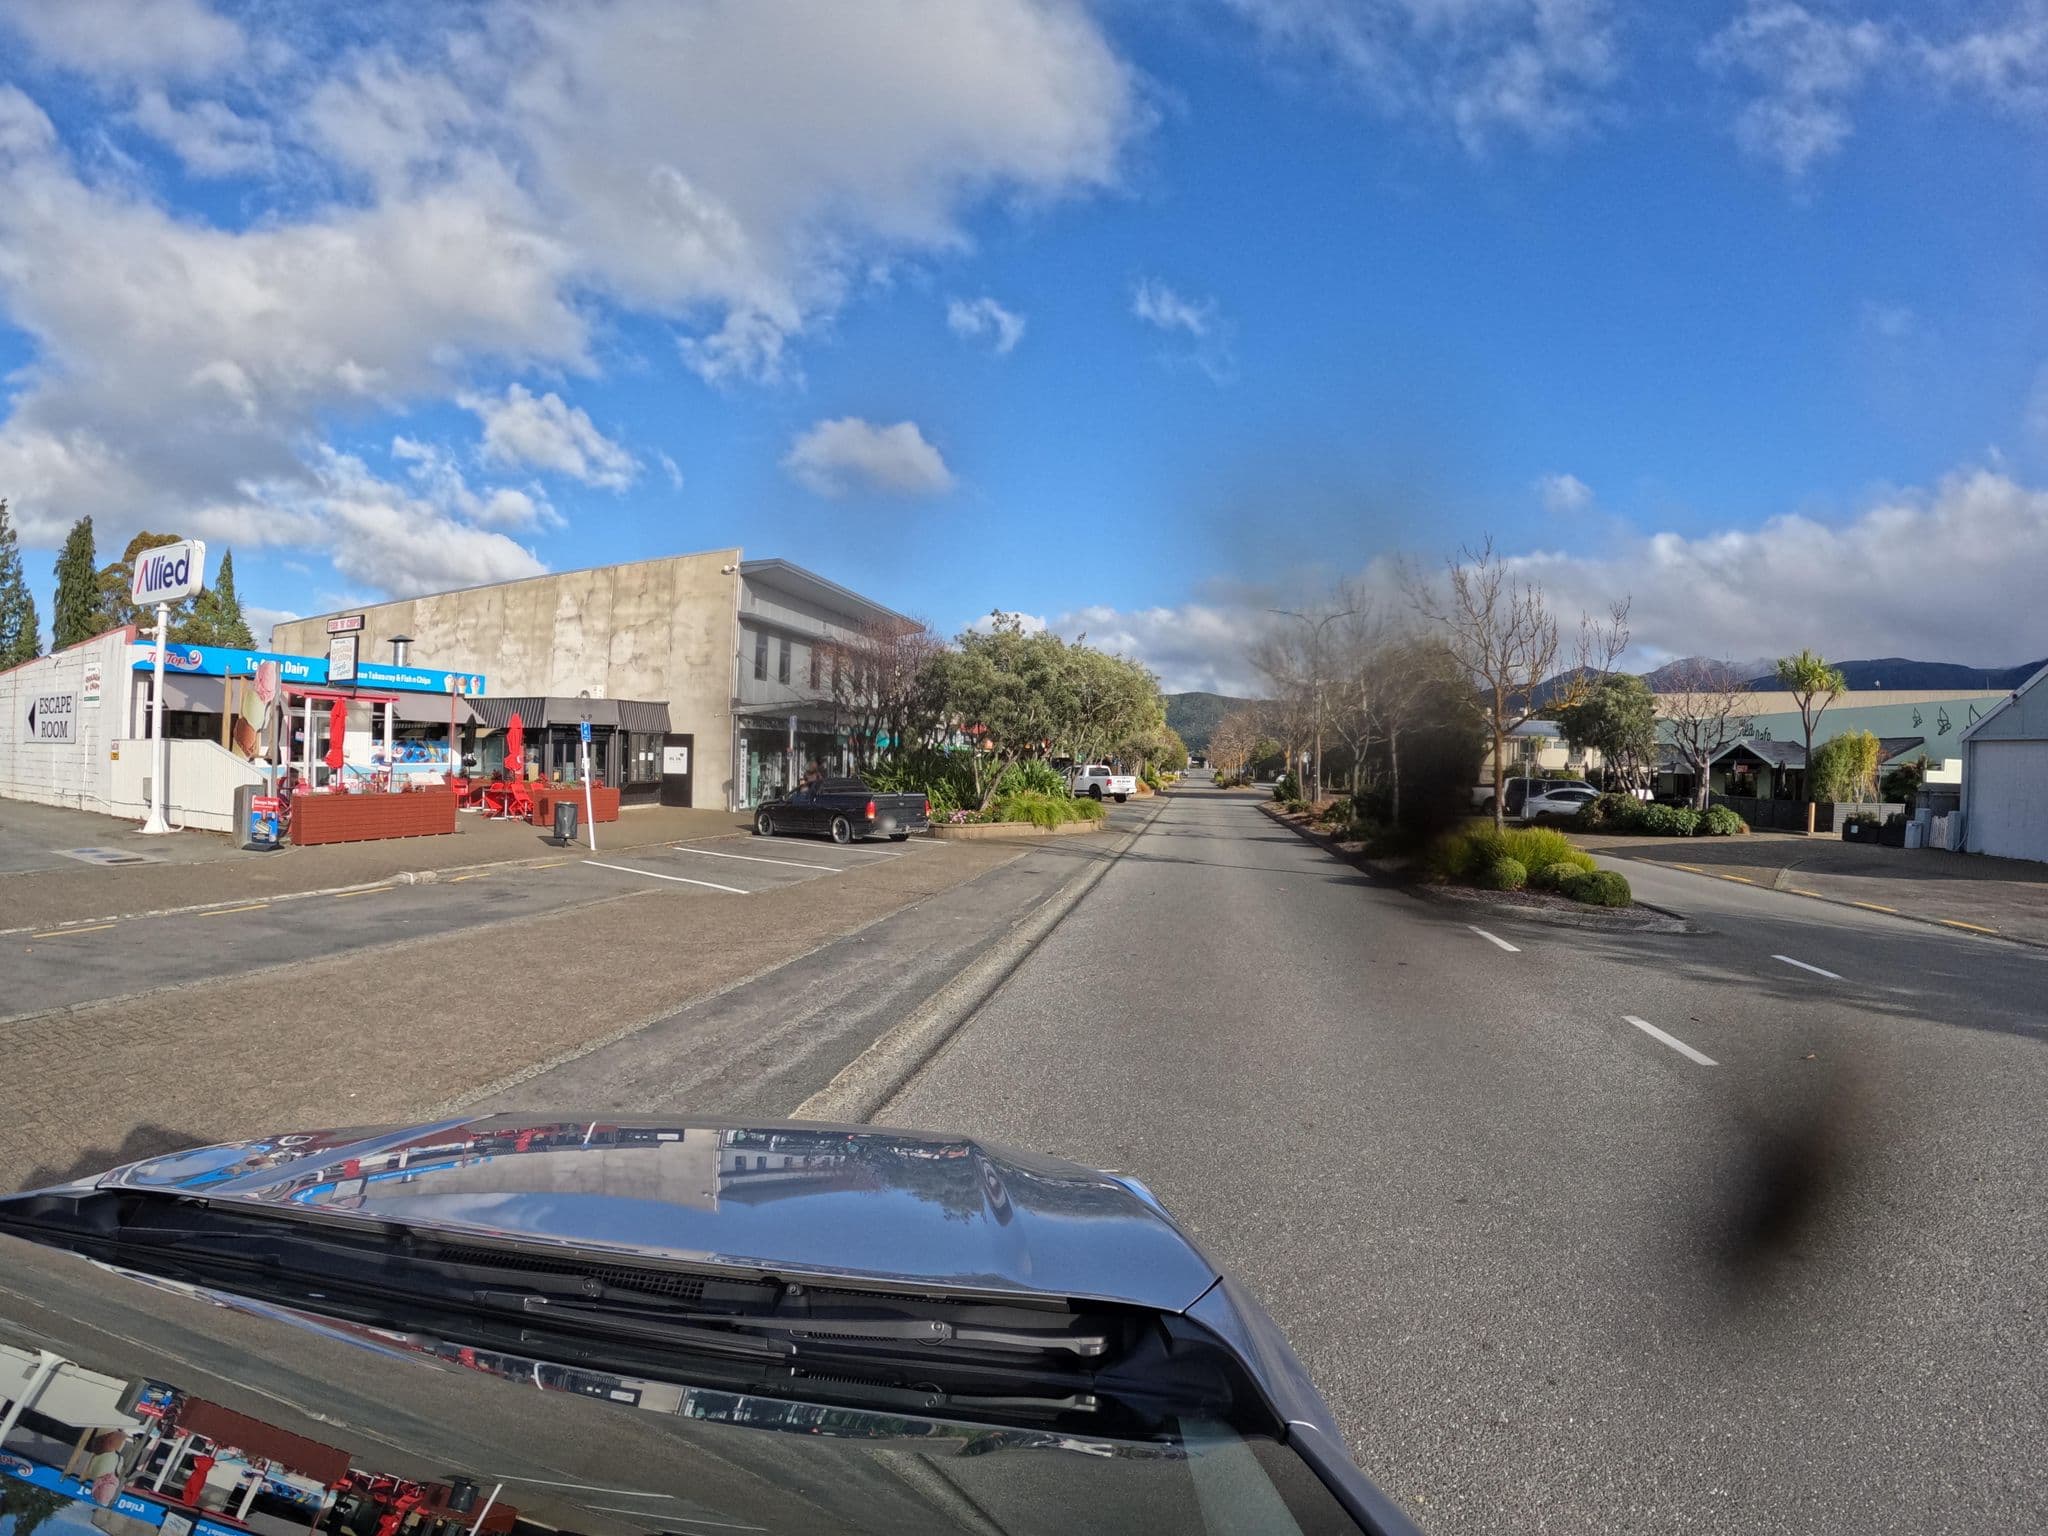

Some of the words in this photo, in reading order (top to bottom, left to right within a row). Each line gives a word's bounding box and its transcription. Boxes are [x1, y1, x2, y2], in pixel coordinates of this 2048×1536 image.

[136, 549, 190, 594] Allied
[166, 653, 187, 666] Top
[246, 657, 258, 671] Te
[285, 661, 310, 677] Dairy
[40, 696, 72, 714] ESCAPE
[41, 721, 68, 738] ROOM
